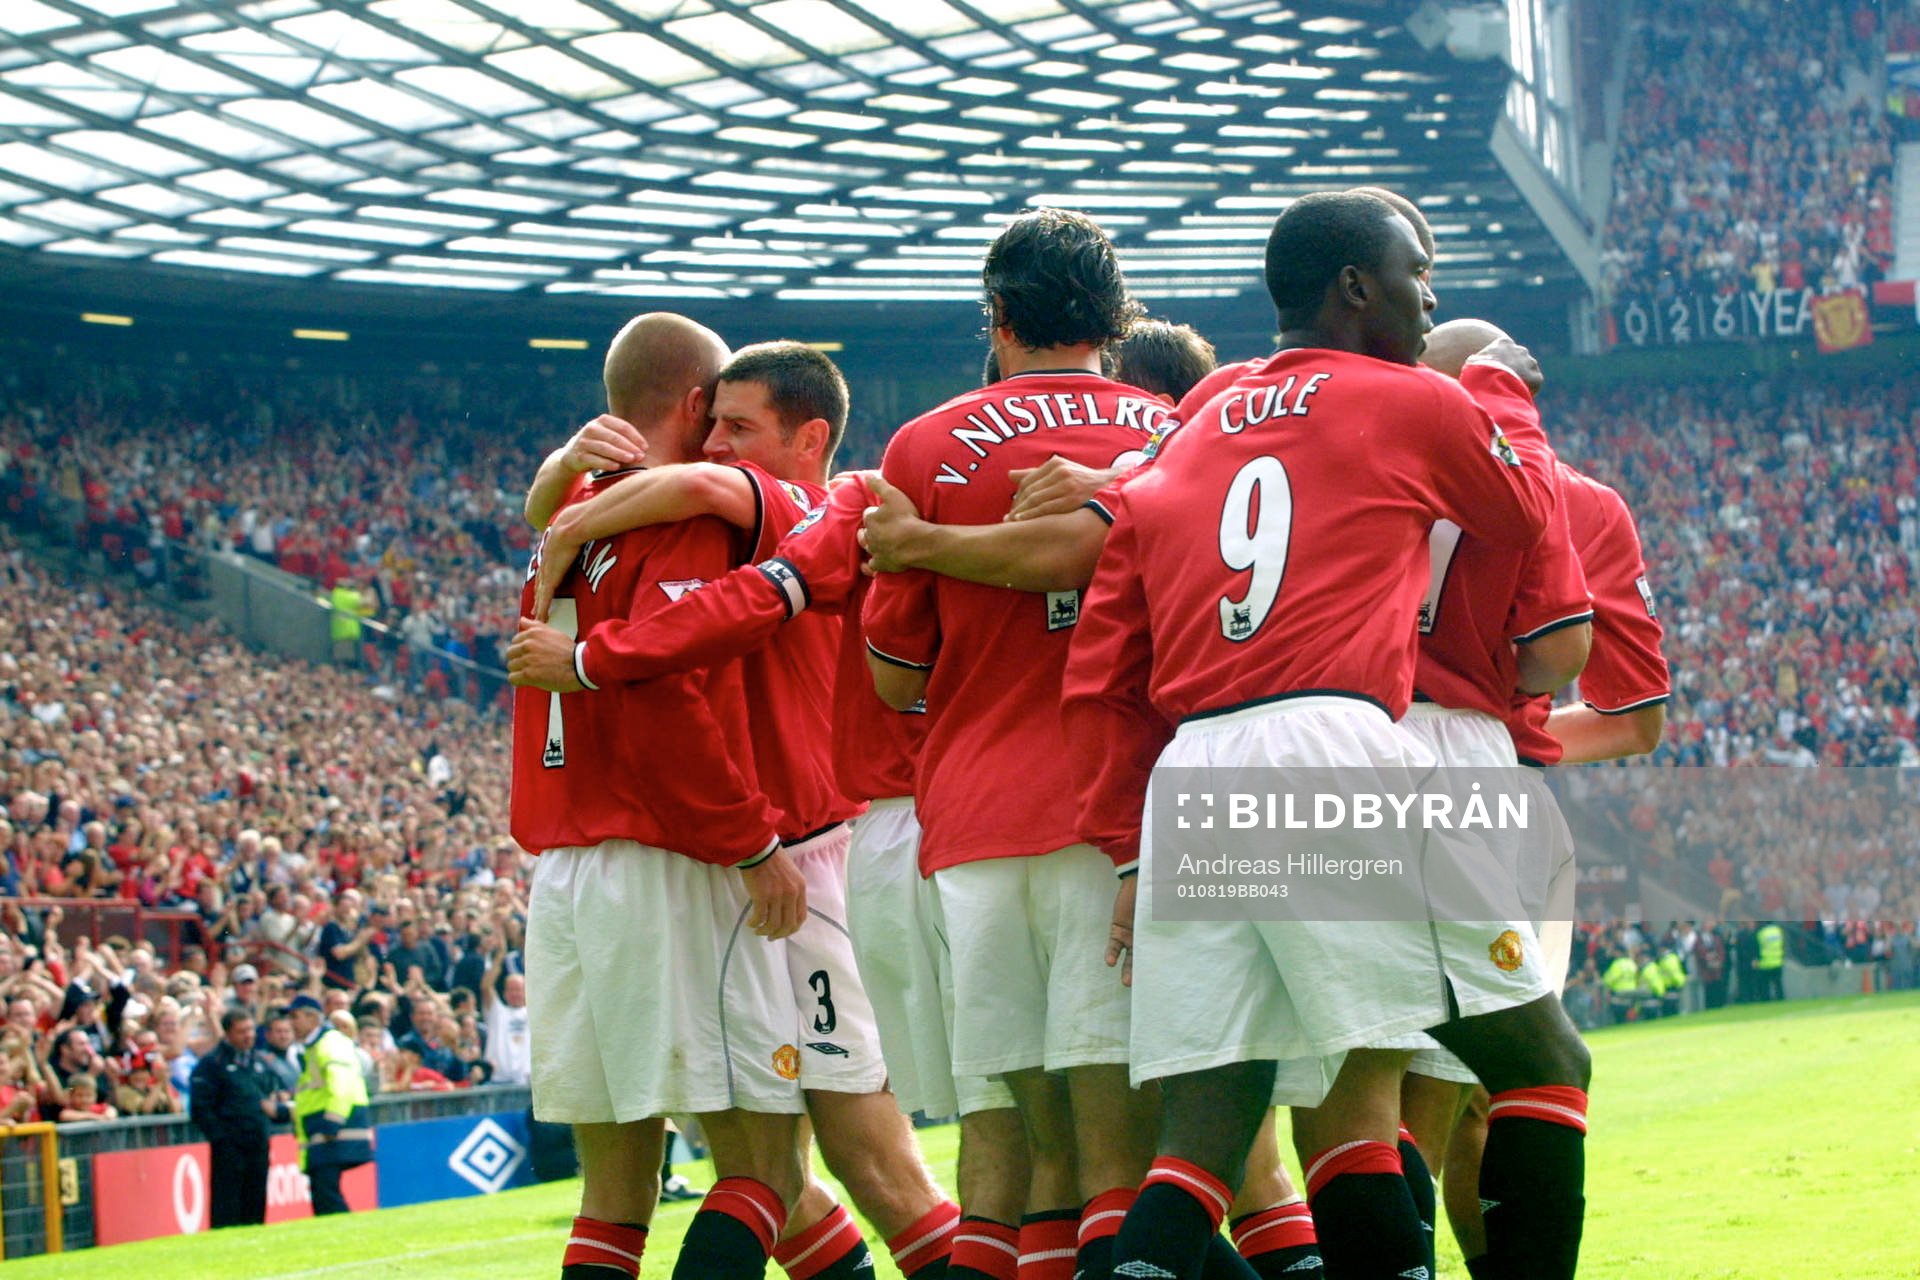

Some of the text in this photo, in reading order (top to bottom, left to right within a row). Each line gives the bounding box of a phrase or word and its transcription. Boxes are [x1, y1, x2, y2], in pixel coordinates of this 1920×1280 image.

[1219, 373, 1332, 434] COLE
[1218, 455, 1293, 643] 9
[808, 969, 837, 1035] 3
